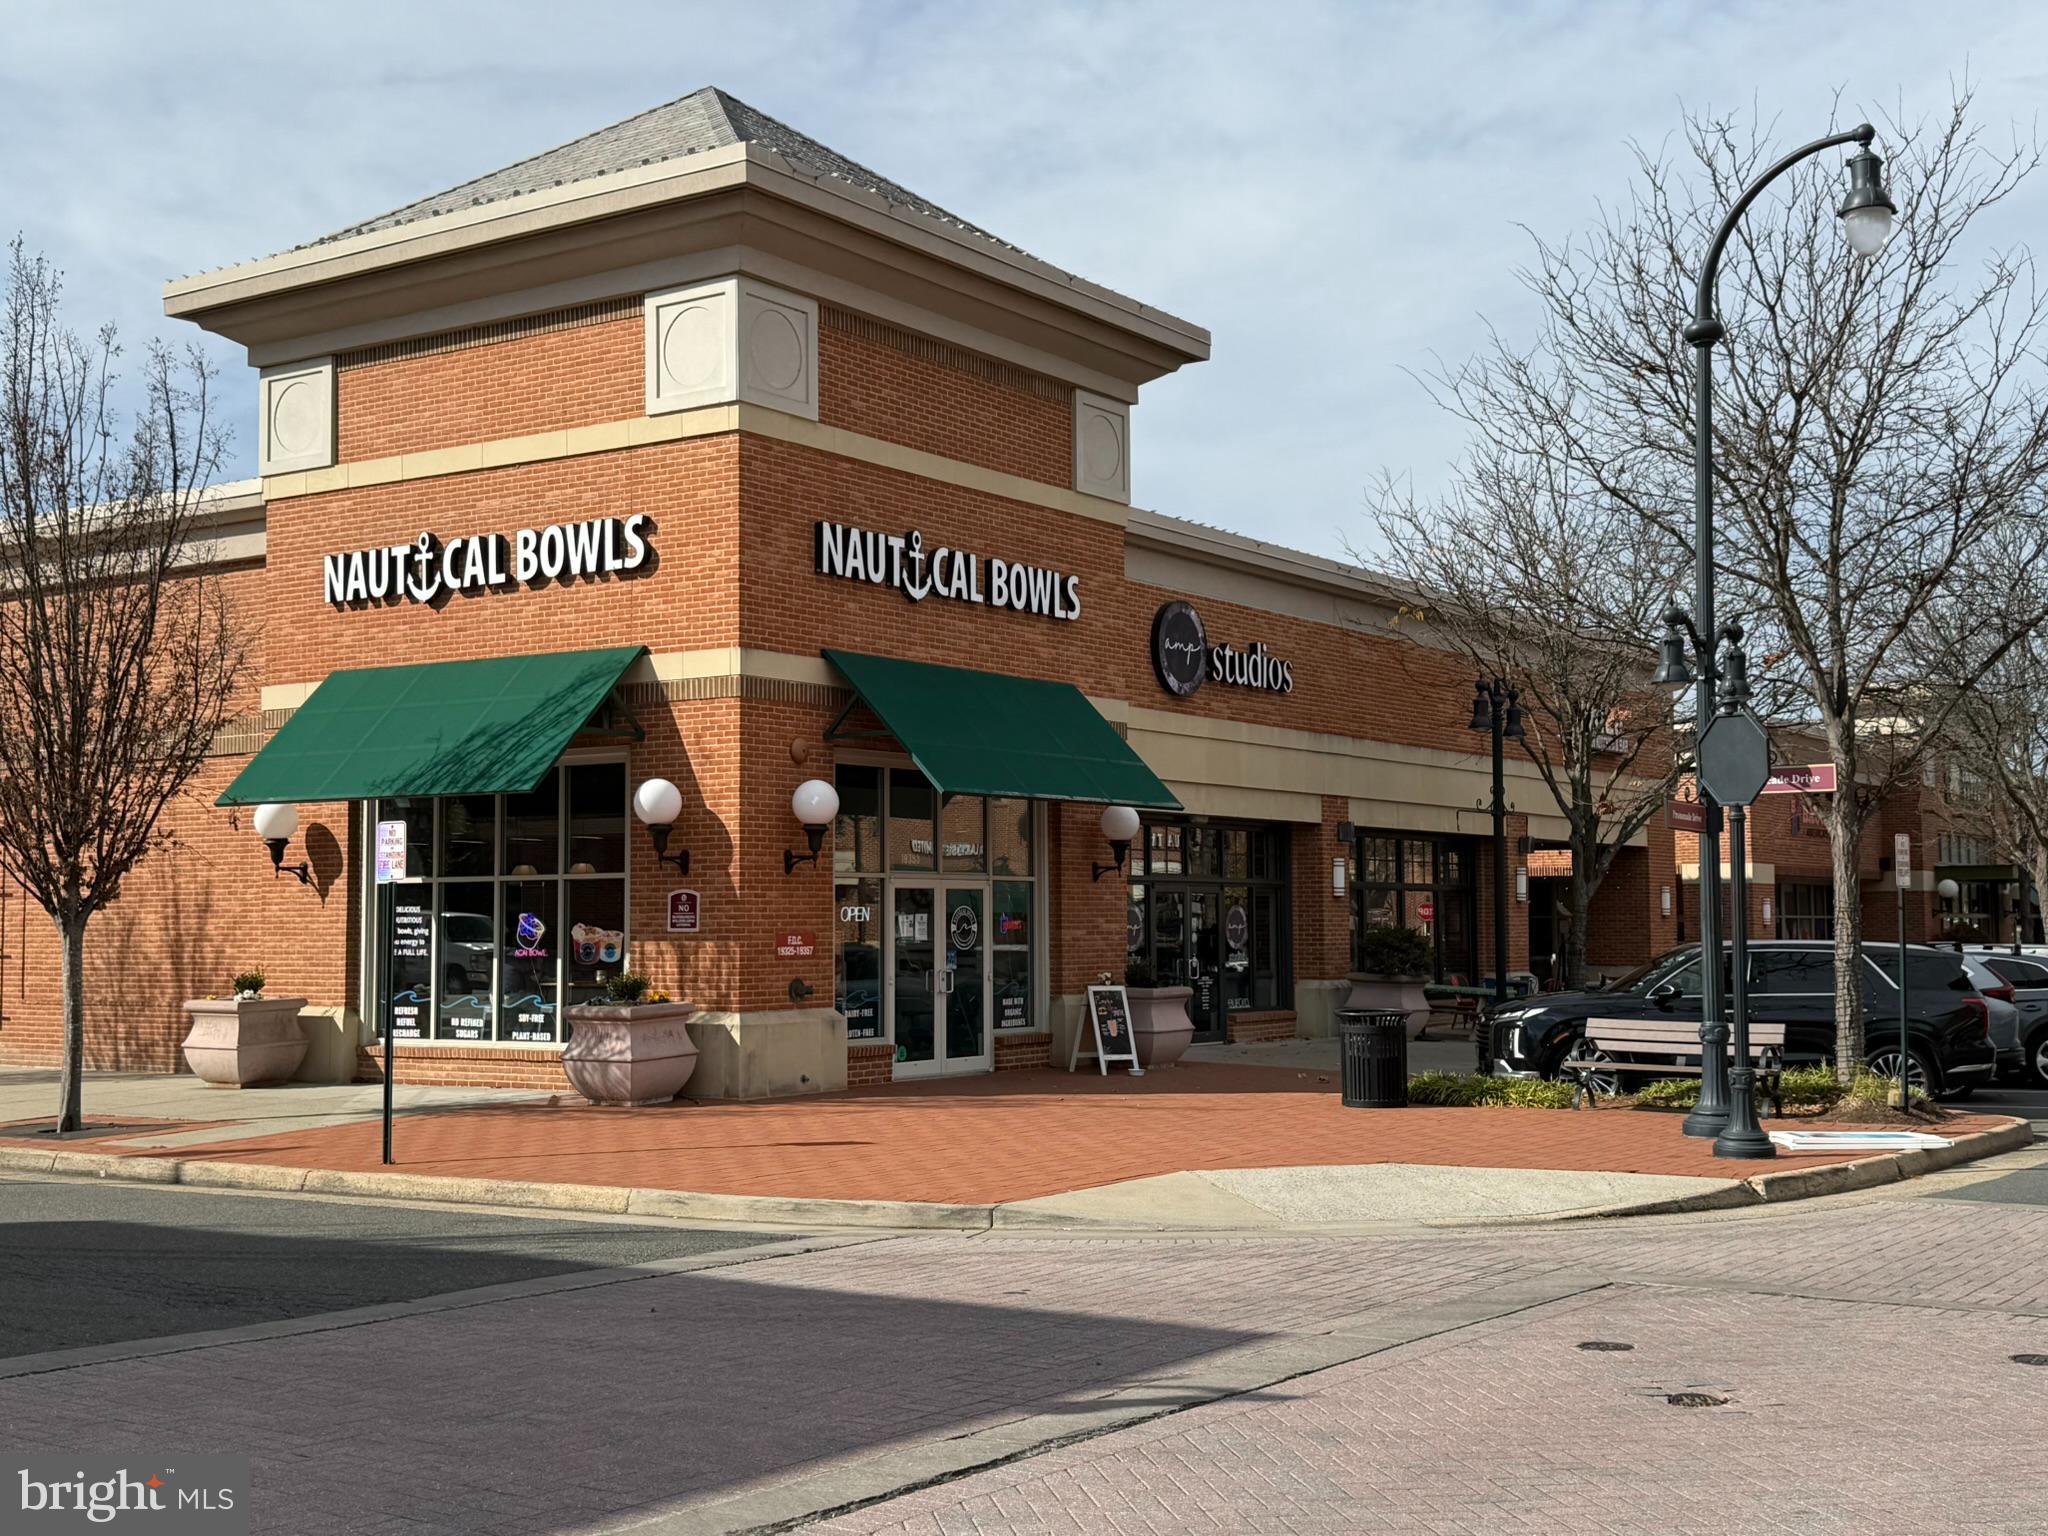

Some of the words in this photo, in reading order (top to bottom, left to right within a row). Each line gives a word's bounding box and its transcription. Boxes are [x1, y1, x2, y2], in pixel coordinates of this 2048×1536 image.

[516, 513, 648, 583] BOWLS
[988, 557, 1082, 621] BOWLS
[1164, 637, 1201, 666] amp
[1212, 641, 1294, 693] studios
[1791, 774, 1821, 784] Drive
[381, 837, 403, 846] PARKING
[391, 860, 404, 870] LANE
[678, 904, 690, 912] NO
[840, 906, 870, 922] OPEN
[414, 927, 430, 936] giving
[400, 939, 419, 947] energy
[1014, 997, 1024, 1005] WITH
[394, 1006, 418, 1015] REFRESH
[396, 1017, 416, 1026] REFUEL
[451, 1017, 459, 1026] NO
[460, 1018, 484, 1027] REFINED
[518, 1013, 545, 1023] SOY-FREE
[455, 1029, 479, 1039] SUGARS
[512, 1031, 551, 1041] PLANT-BASED
